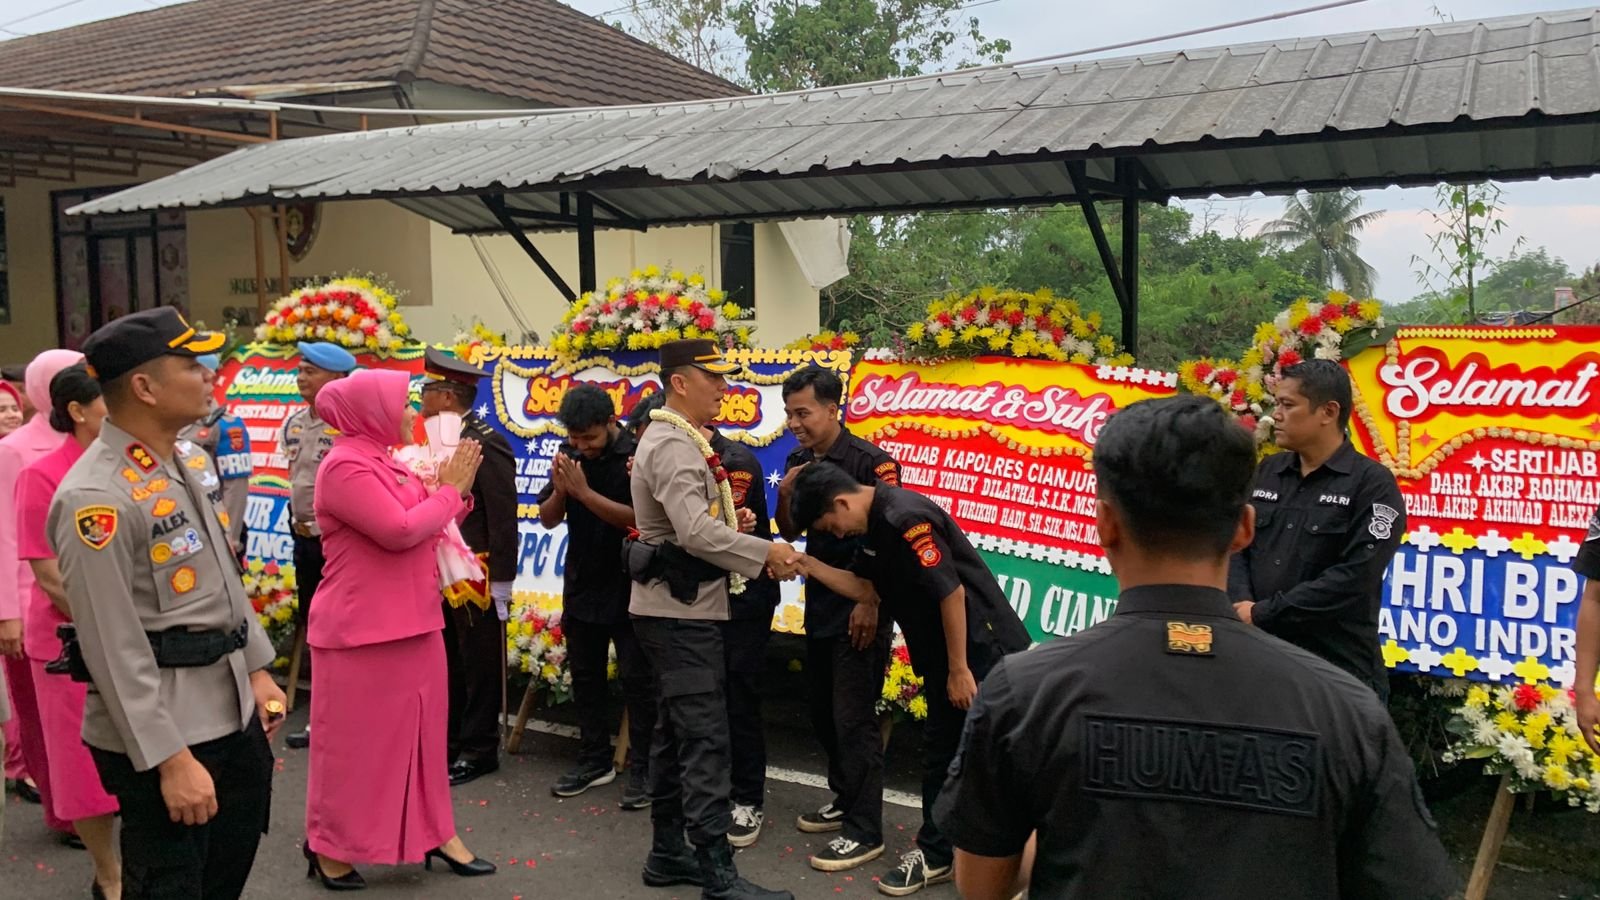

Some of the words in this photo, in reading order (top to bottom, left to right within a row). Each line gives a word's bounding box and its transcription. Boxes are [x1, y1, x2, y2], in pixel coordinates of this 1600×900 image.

[850, 376, 996, 416] Selamat
[991, 390, 1025, 418] &
[1380, 357, 1599, 418] Selamat
[879, 440, 940, 466] SERTIJAB
[943, 448, 1024, 480] KAPOLRES
[1028, 463, 1097, 495] CIANJUR
[1490, 448, 1597, 476] SERTIJAB
[938, 471, 978, 493] YONKY
[1319, 494, 1351, 506] POLRI
[1430, 472, 1472, 496] DARI
[1476, 474, 1525, 500] AKBP
[152, 511, 190, 539] ALEX
[956, 499, 998, 524] YURIKHO
[1402, 494, 1440, 517] PADA
[1442, 496, 1478, 520] AKBP
[1482, 499, 1543, 525] AKHMAD
[1549, 503, 1598, 530] ALEXA
[1383, 552, 1484, 614] HRI
[1503, 561, 1586, 624] BP
[1040, 584, 1119, 637] CIAN
[1087, 720, 1314, 804] HUMAS
